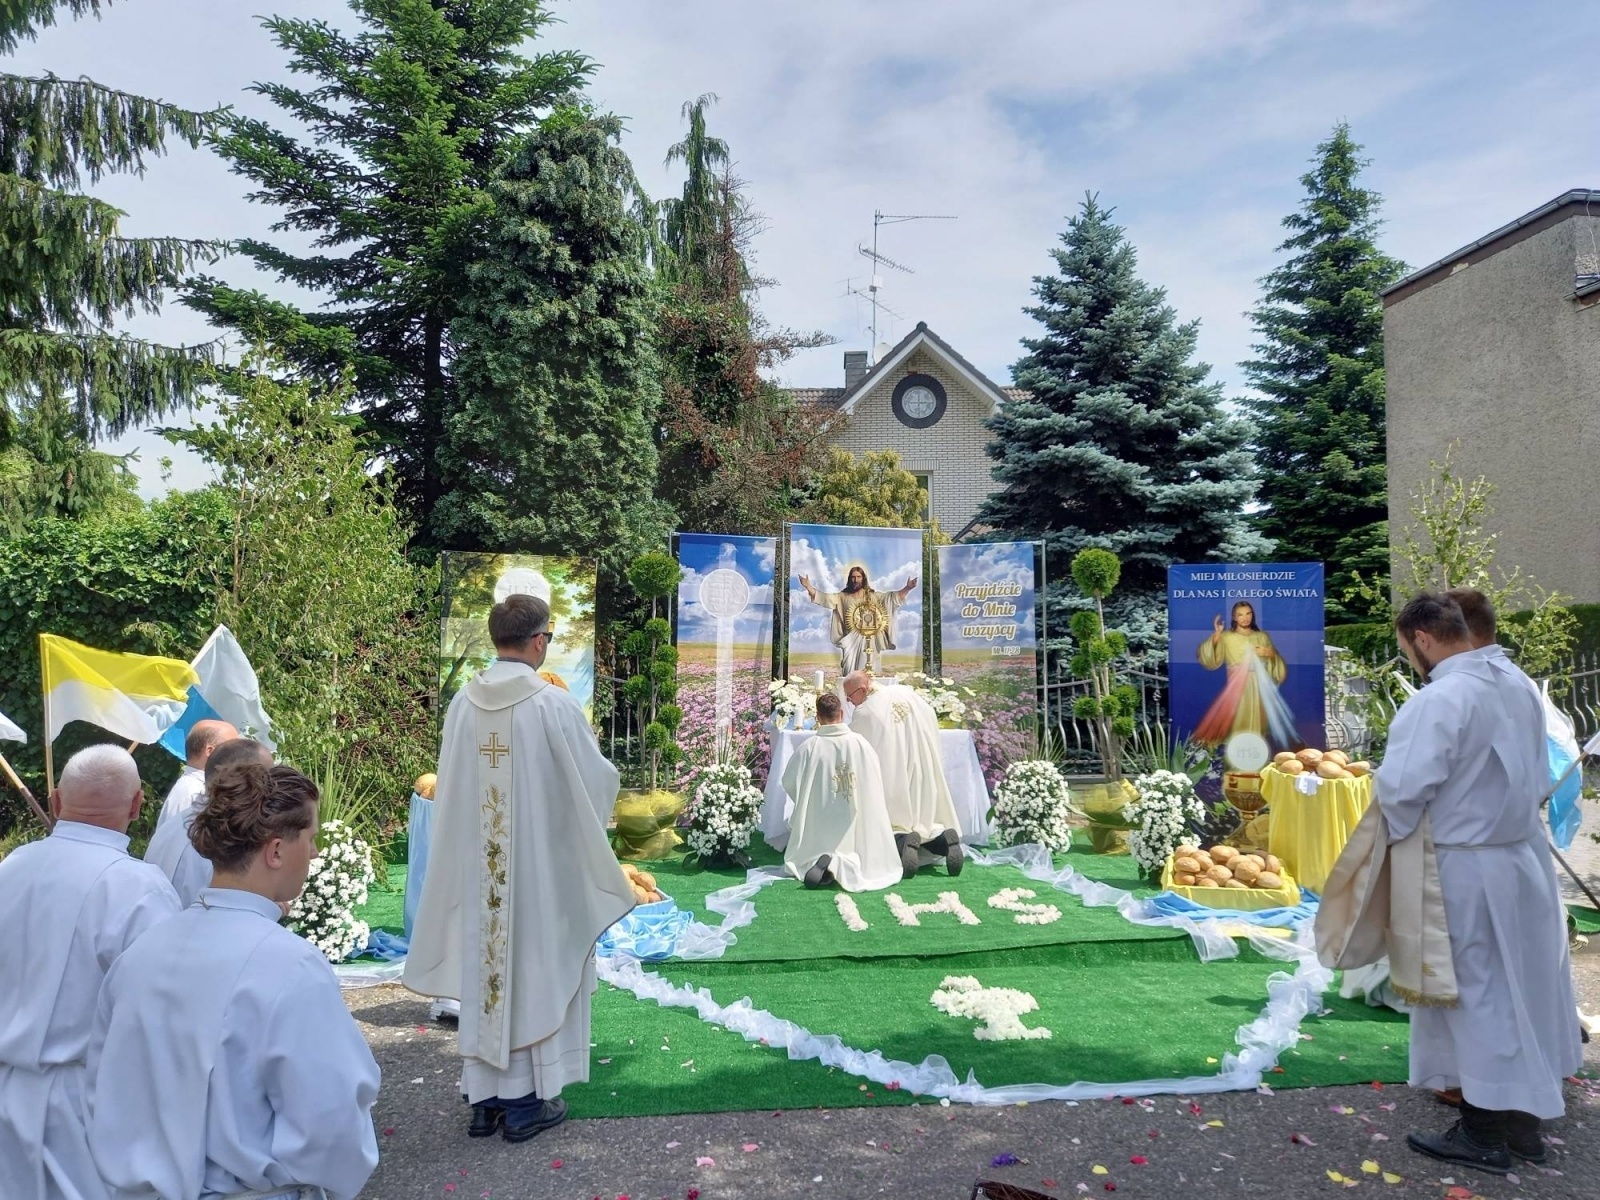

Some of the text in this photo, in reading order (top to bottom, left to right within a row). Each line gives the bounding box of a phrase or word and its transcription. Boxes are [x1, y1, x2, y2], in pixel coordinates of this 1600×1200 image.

[1190, 571, 1296, 581] MIEJ MIŁOSIERDZIE
[955, 581, 1022, 602] Przyjdźcie
[1173, 587, 1318, 598] DLA NAS I CAŁEGO ŚWIATA
[961, 601, 1017, 618] do Mnie
[962, 623, 1017, 641] wszyscy
[833, 887, 1063, 931] IHS
